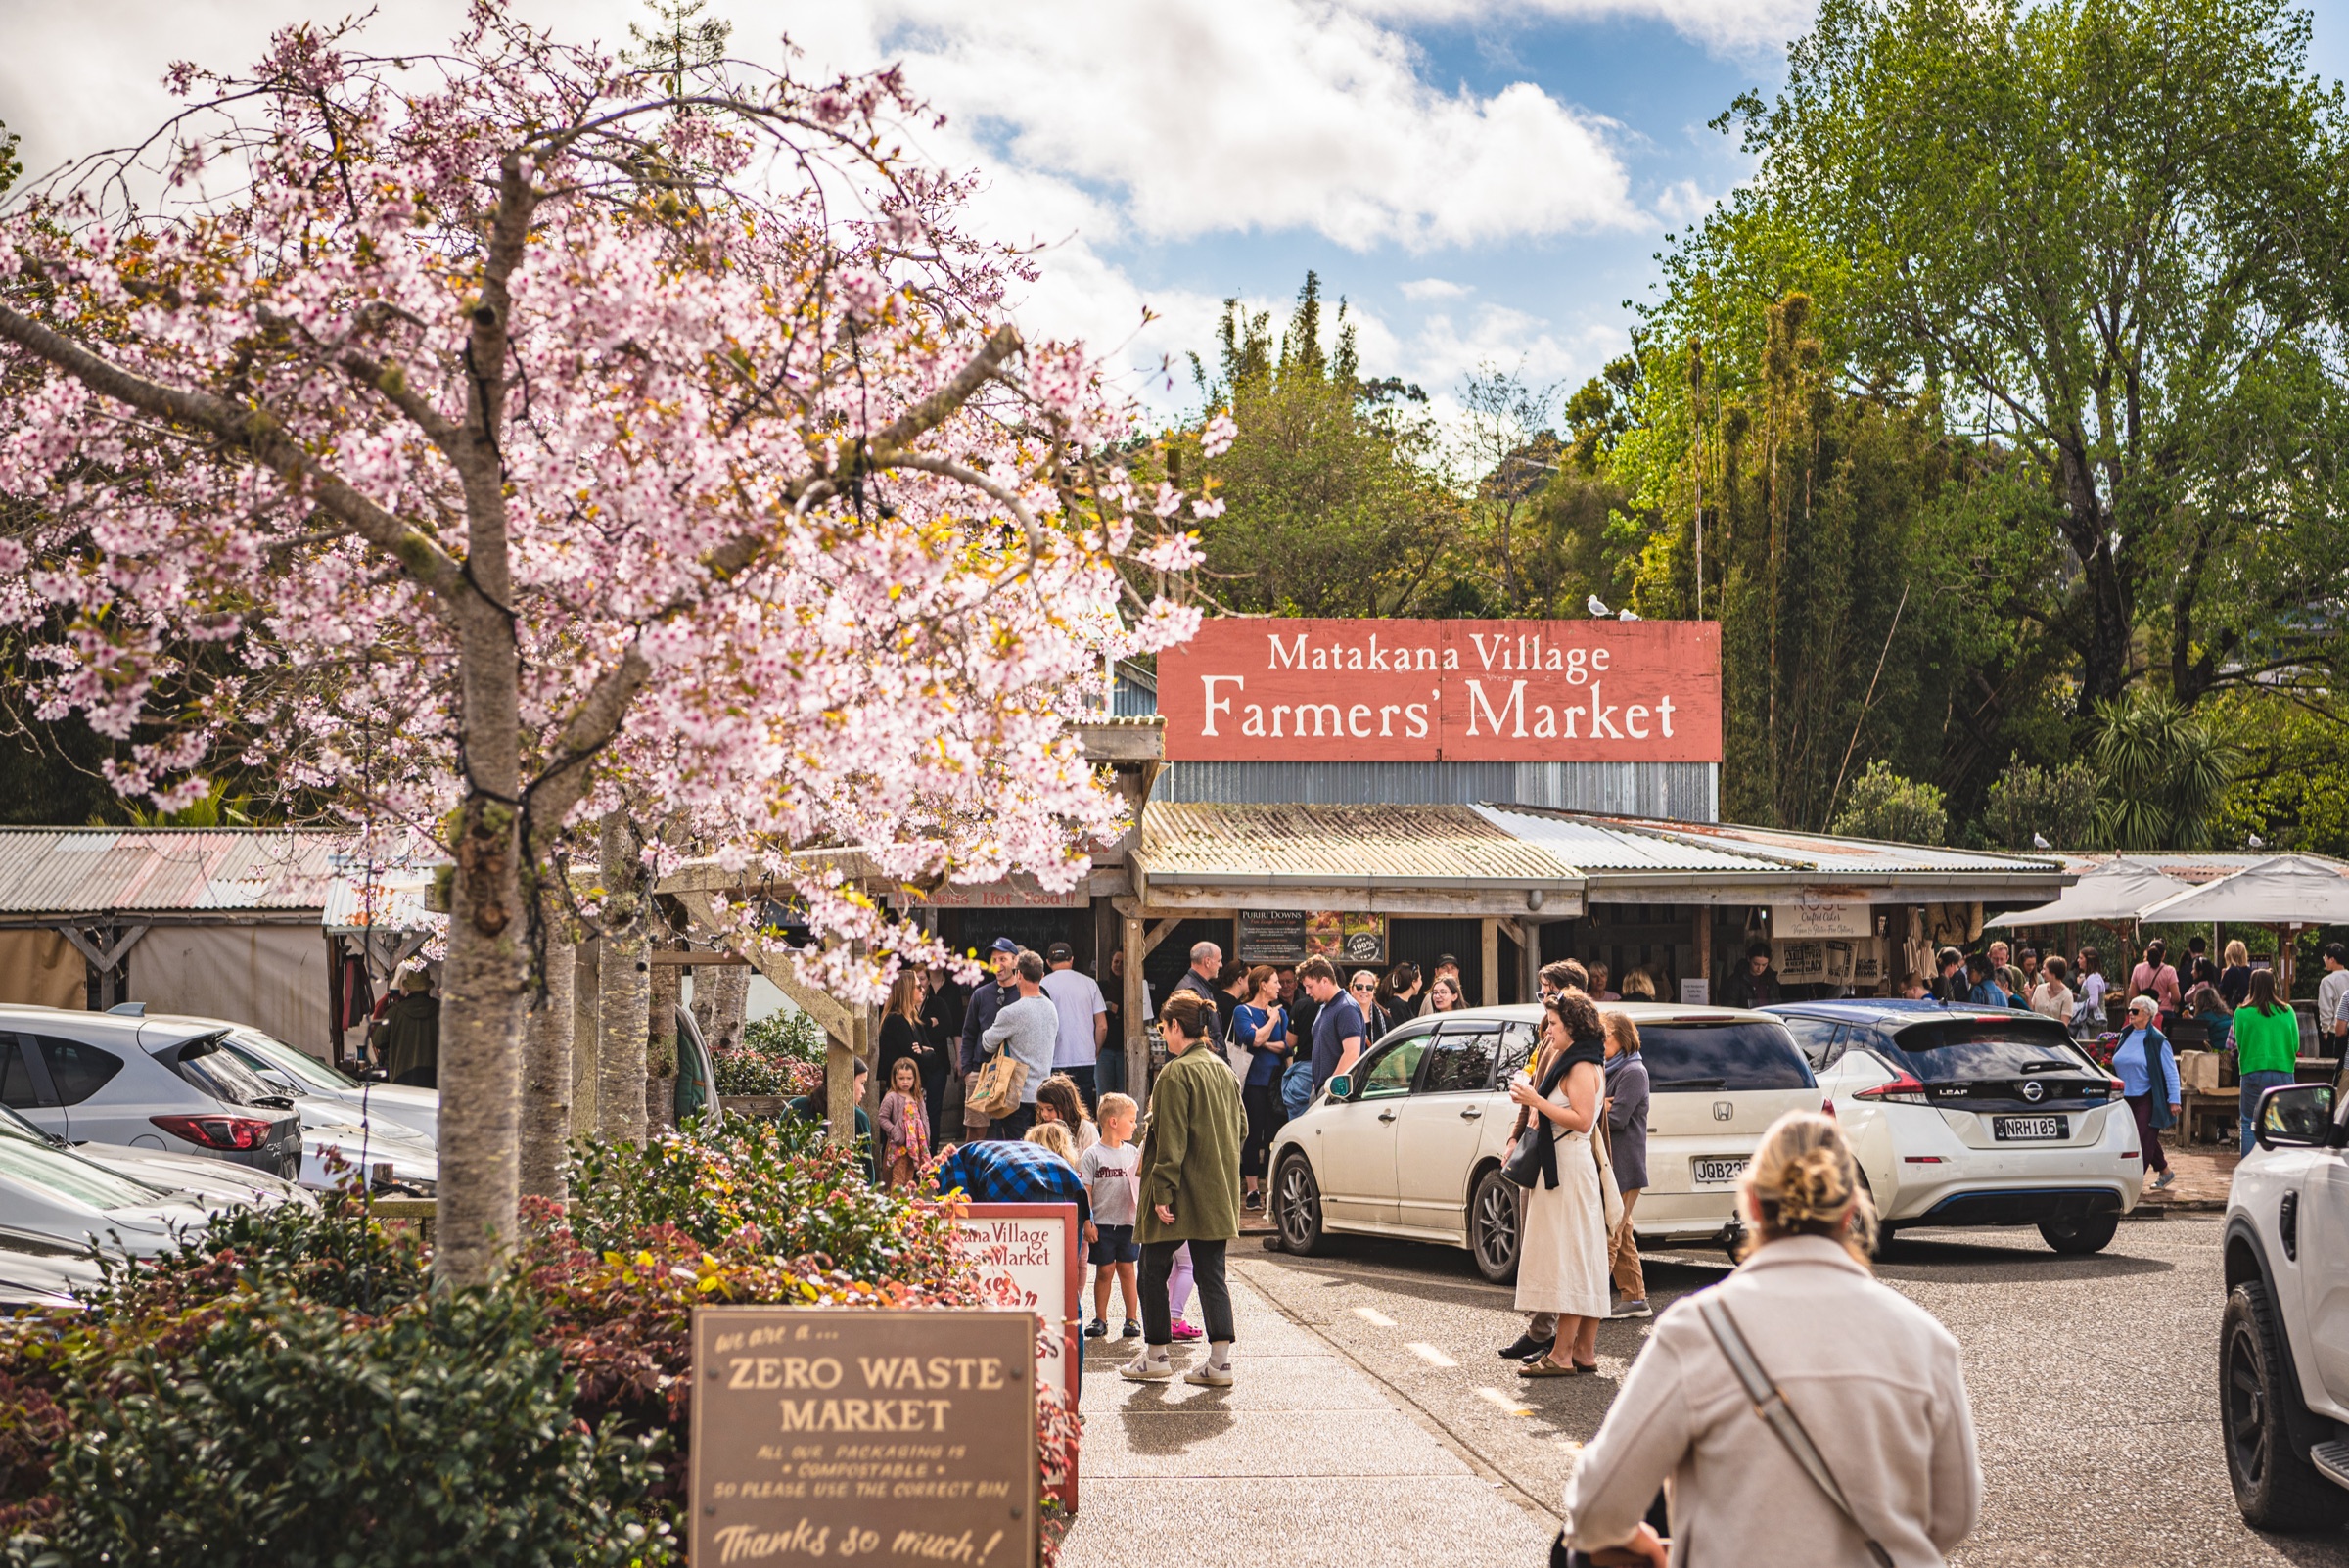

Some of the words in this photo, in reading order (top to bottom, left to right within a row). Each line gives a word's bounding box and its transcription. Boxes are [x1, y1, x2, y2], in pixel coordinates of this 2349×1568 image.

[1267, 632, 1460, 670] Matakana
[1468, 633, 1611, 685] Village
[1200, 674, 1441, 739] Farmers'
[1464, 679, 1677, 740] Market
[982, 891, 1012, 906] Hot
[1024, 892, 1061, 905] Food
[1242, 910, 1269, 919] PURIRI
[1270, 910, 1302, 919] DOWNS
[1352, 940, 1375, 951] 100%
[2005, 1120, 2056, 1136] NRH105
[991, 1222, 1049, 1251] Village
[727, 1356, 844, 1390] ZERO
[856, 1356, 1004, 1390] WASTE
[778, 1398, 952, 1432] MARKET
[756, 1445, 783, 1459] ALL
[835, 1445, 943, 1459] PACKAGING
[797, 1462, 928, 1479] COMPOSTABLE
[740, 1482, 806, 1499] PLEASE
[813, 1482, 848, 1498] USE
[855, 1482, 887, 1498] THE
[892, 1482, 972, 1498] CORRECT
[976, 1482, 1010, 1498] BIN
[713, 1517, 831, 1565] Thanks
